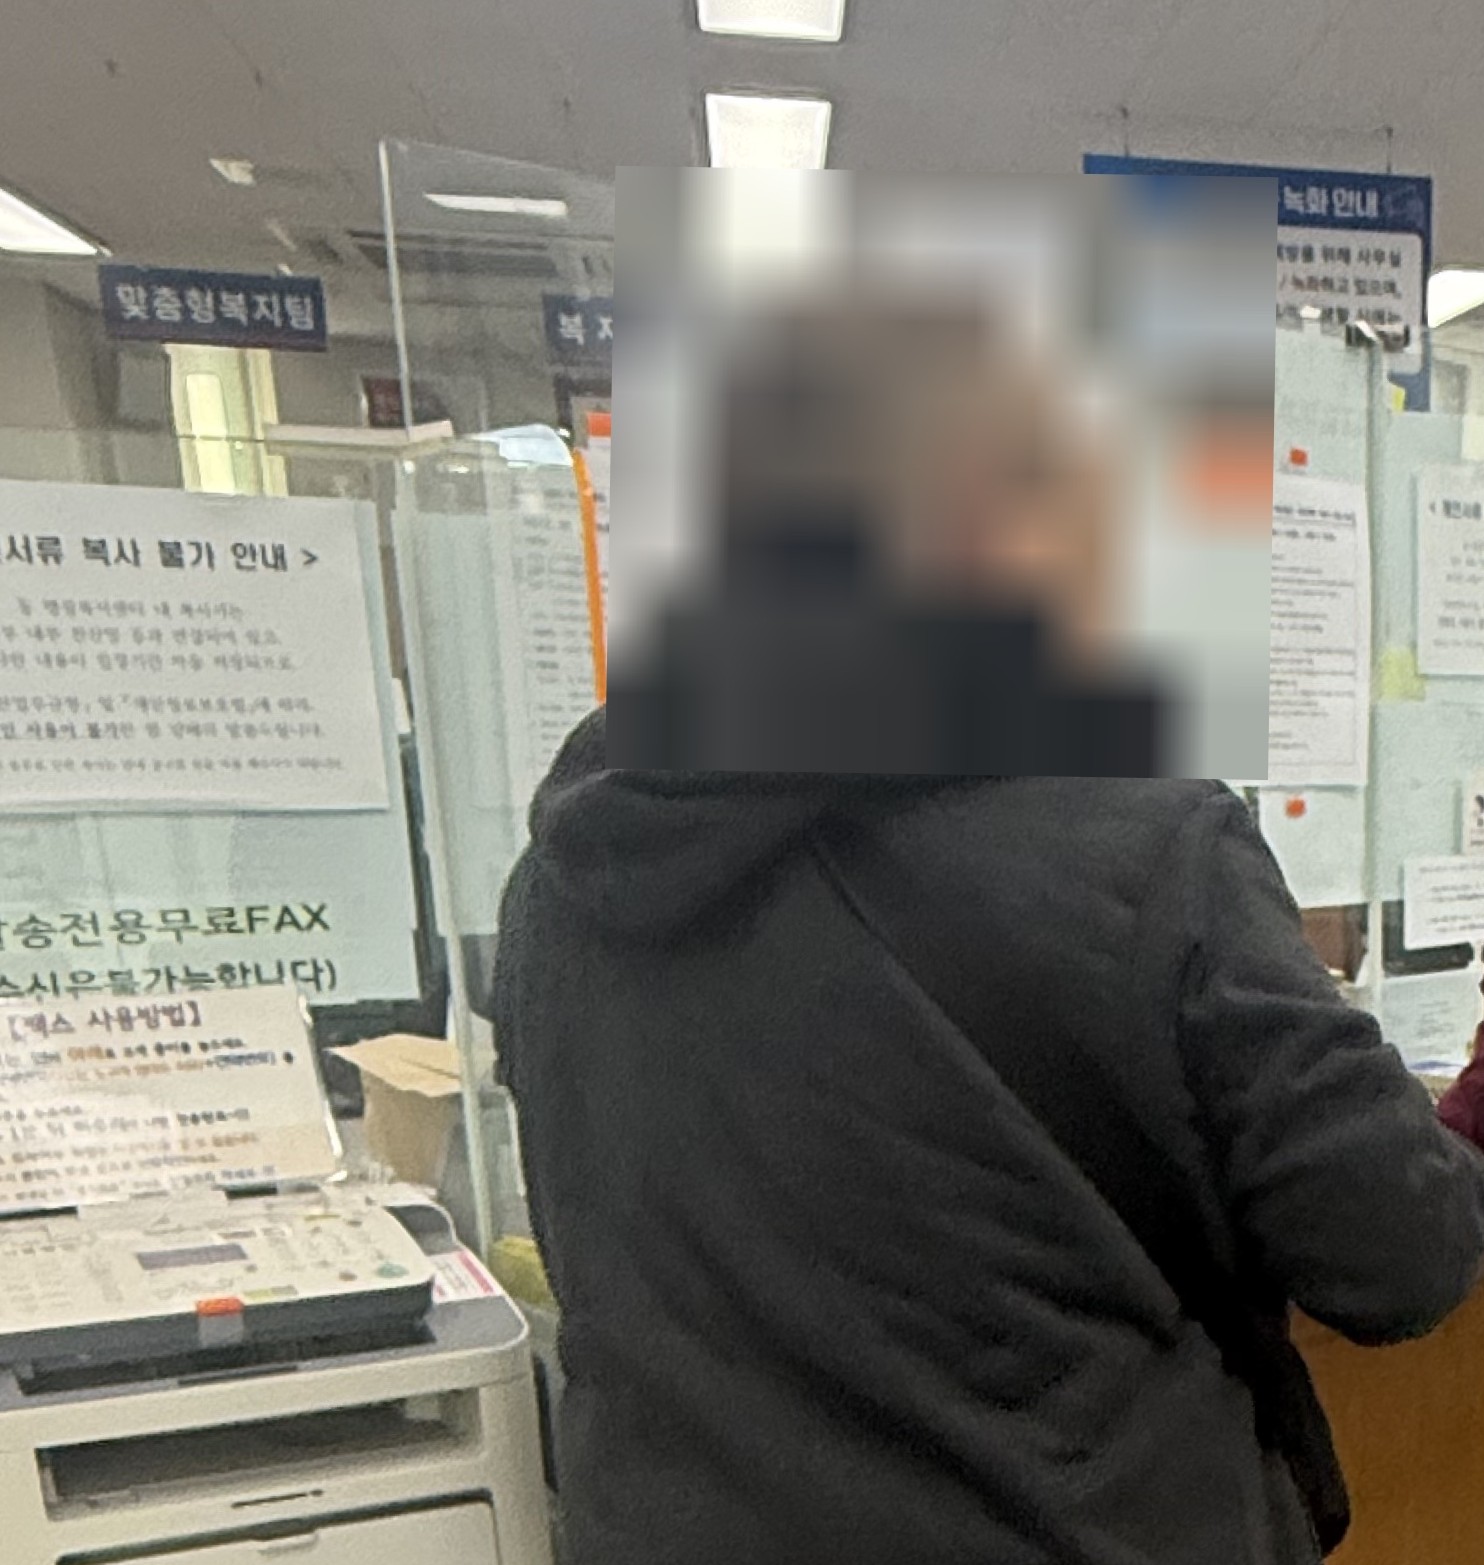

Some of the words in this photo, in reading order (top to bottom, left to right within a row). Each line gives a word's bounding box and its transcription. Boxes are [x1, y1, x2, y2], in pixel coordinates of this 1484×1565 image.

[1332, 188, 1379, 218] 안내
[115, 282, 315, 331] 맞춤형복지팀
[0, 534, 64, 565] 서류
[82, 537, 141, 567] 복사
[158, 540, 215, 571] 불가
[230, 541, 288, 572] 안내
